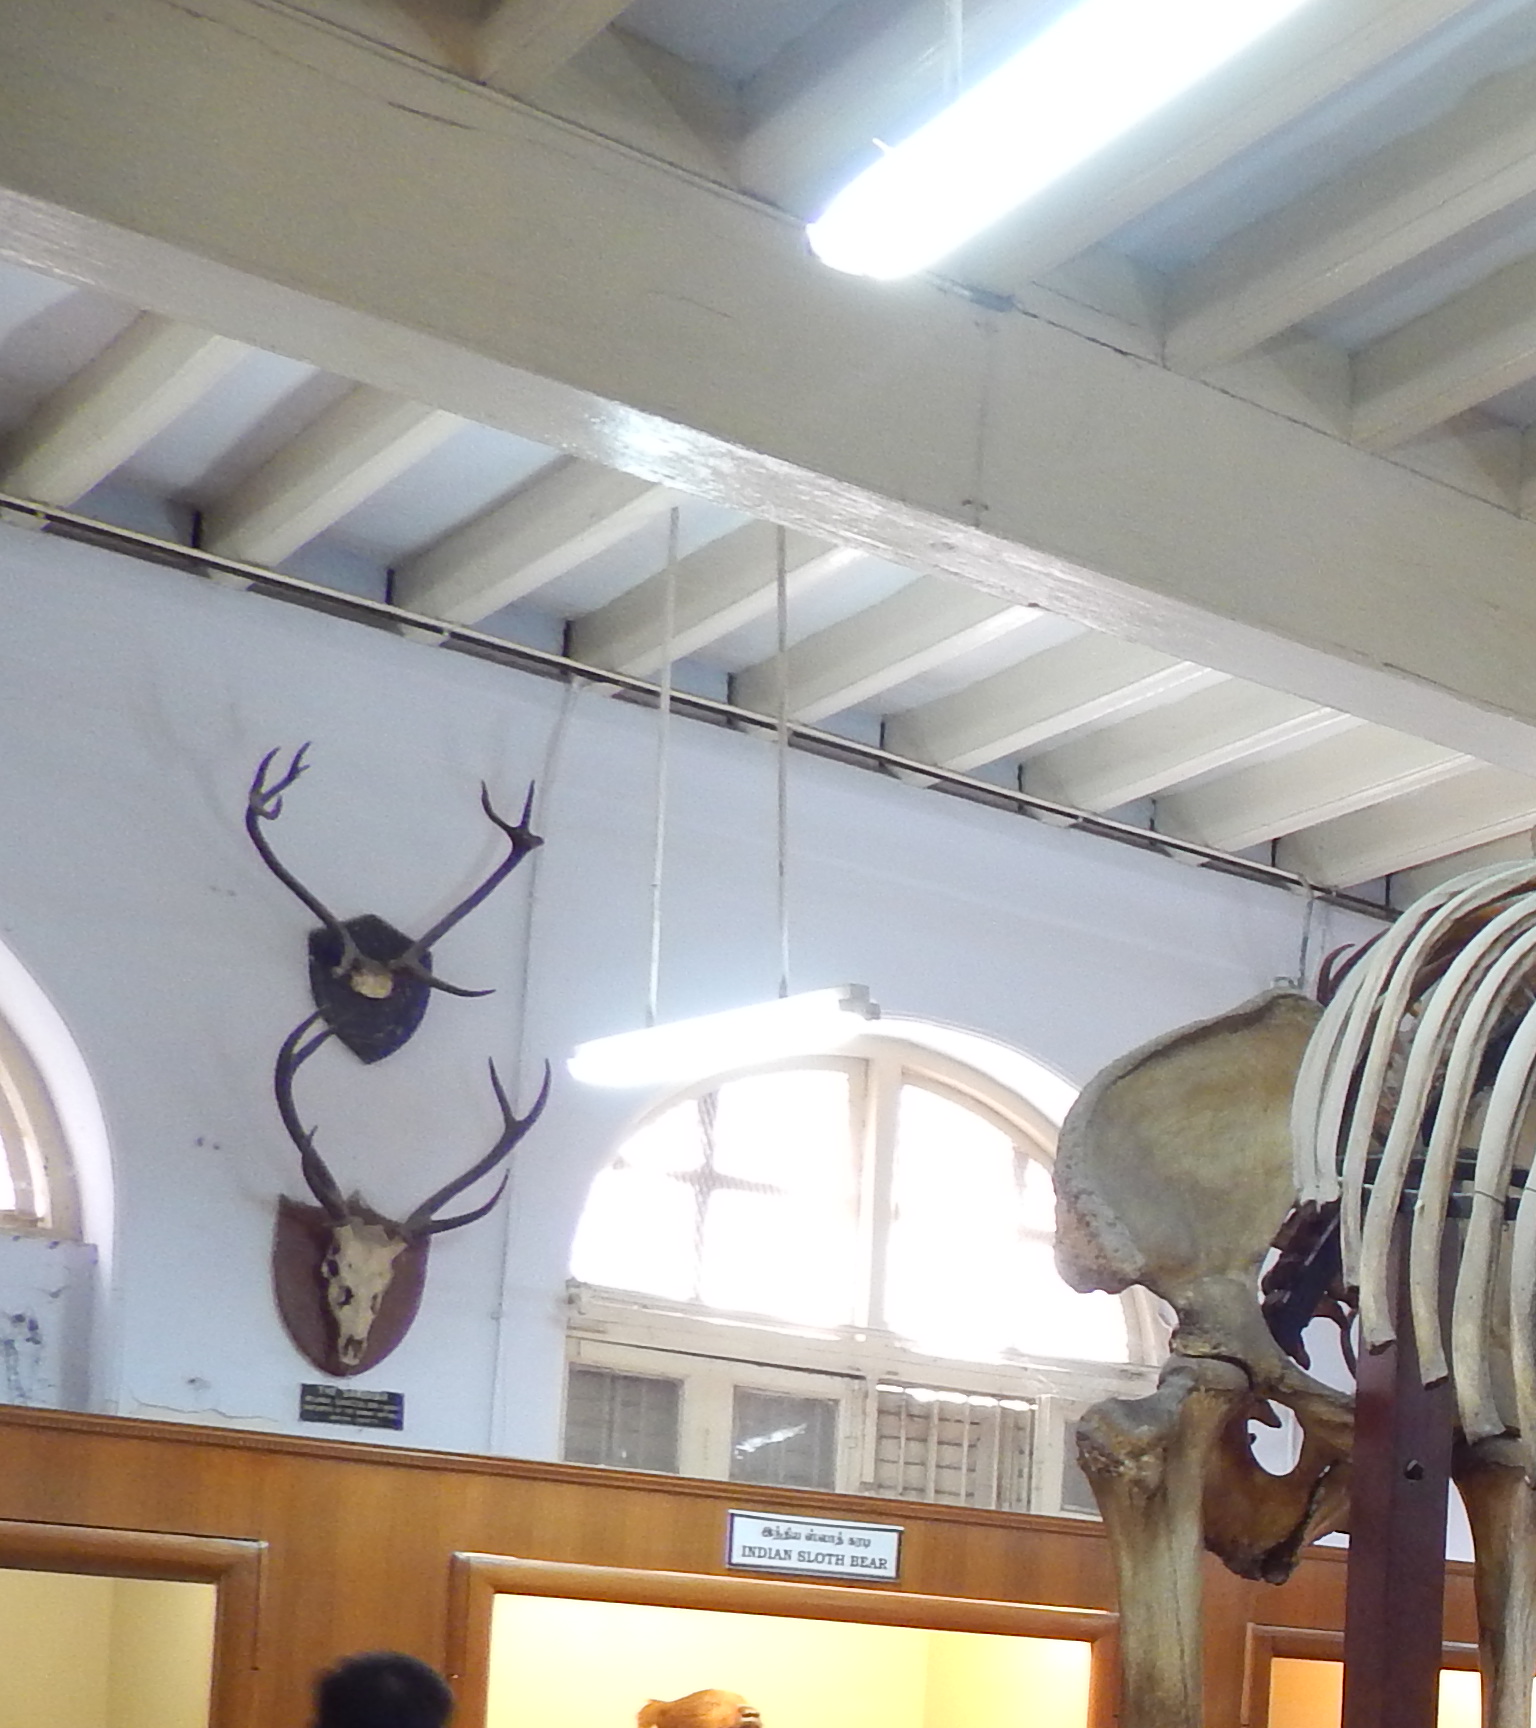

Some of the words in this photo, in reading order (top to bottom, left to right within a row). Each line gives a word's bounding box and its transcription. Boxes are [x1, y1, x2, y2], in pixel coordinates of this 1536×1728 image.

[741, 1545, 792, 1561] INDIAN
[797, 1550, 845, 1567] SLOTH
[849, 1555, 888, 1570] BEAR
